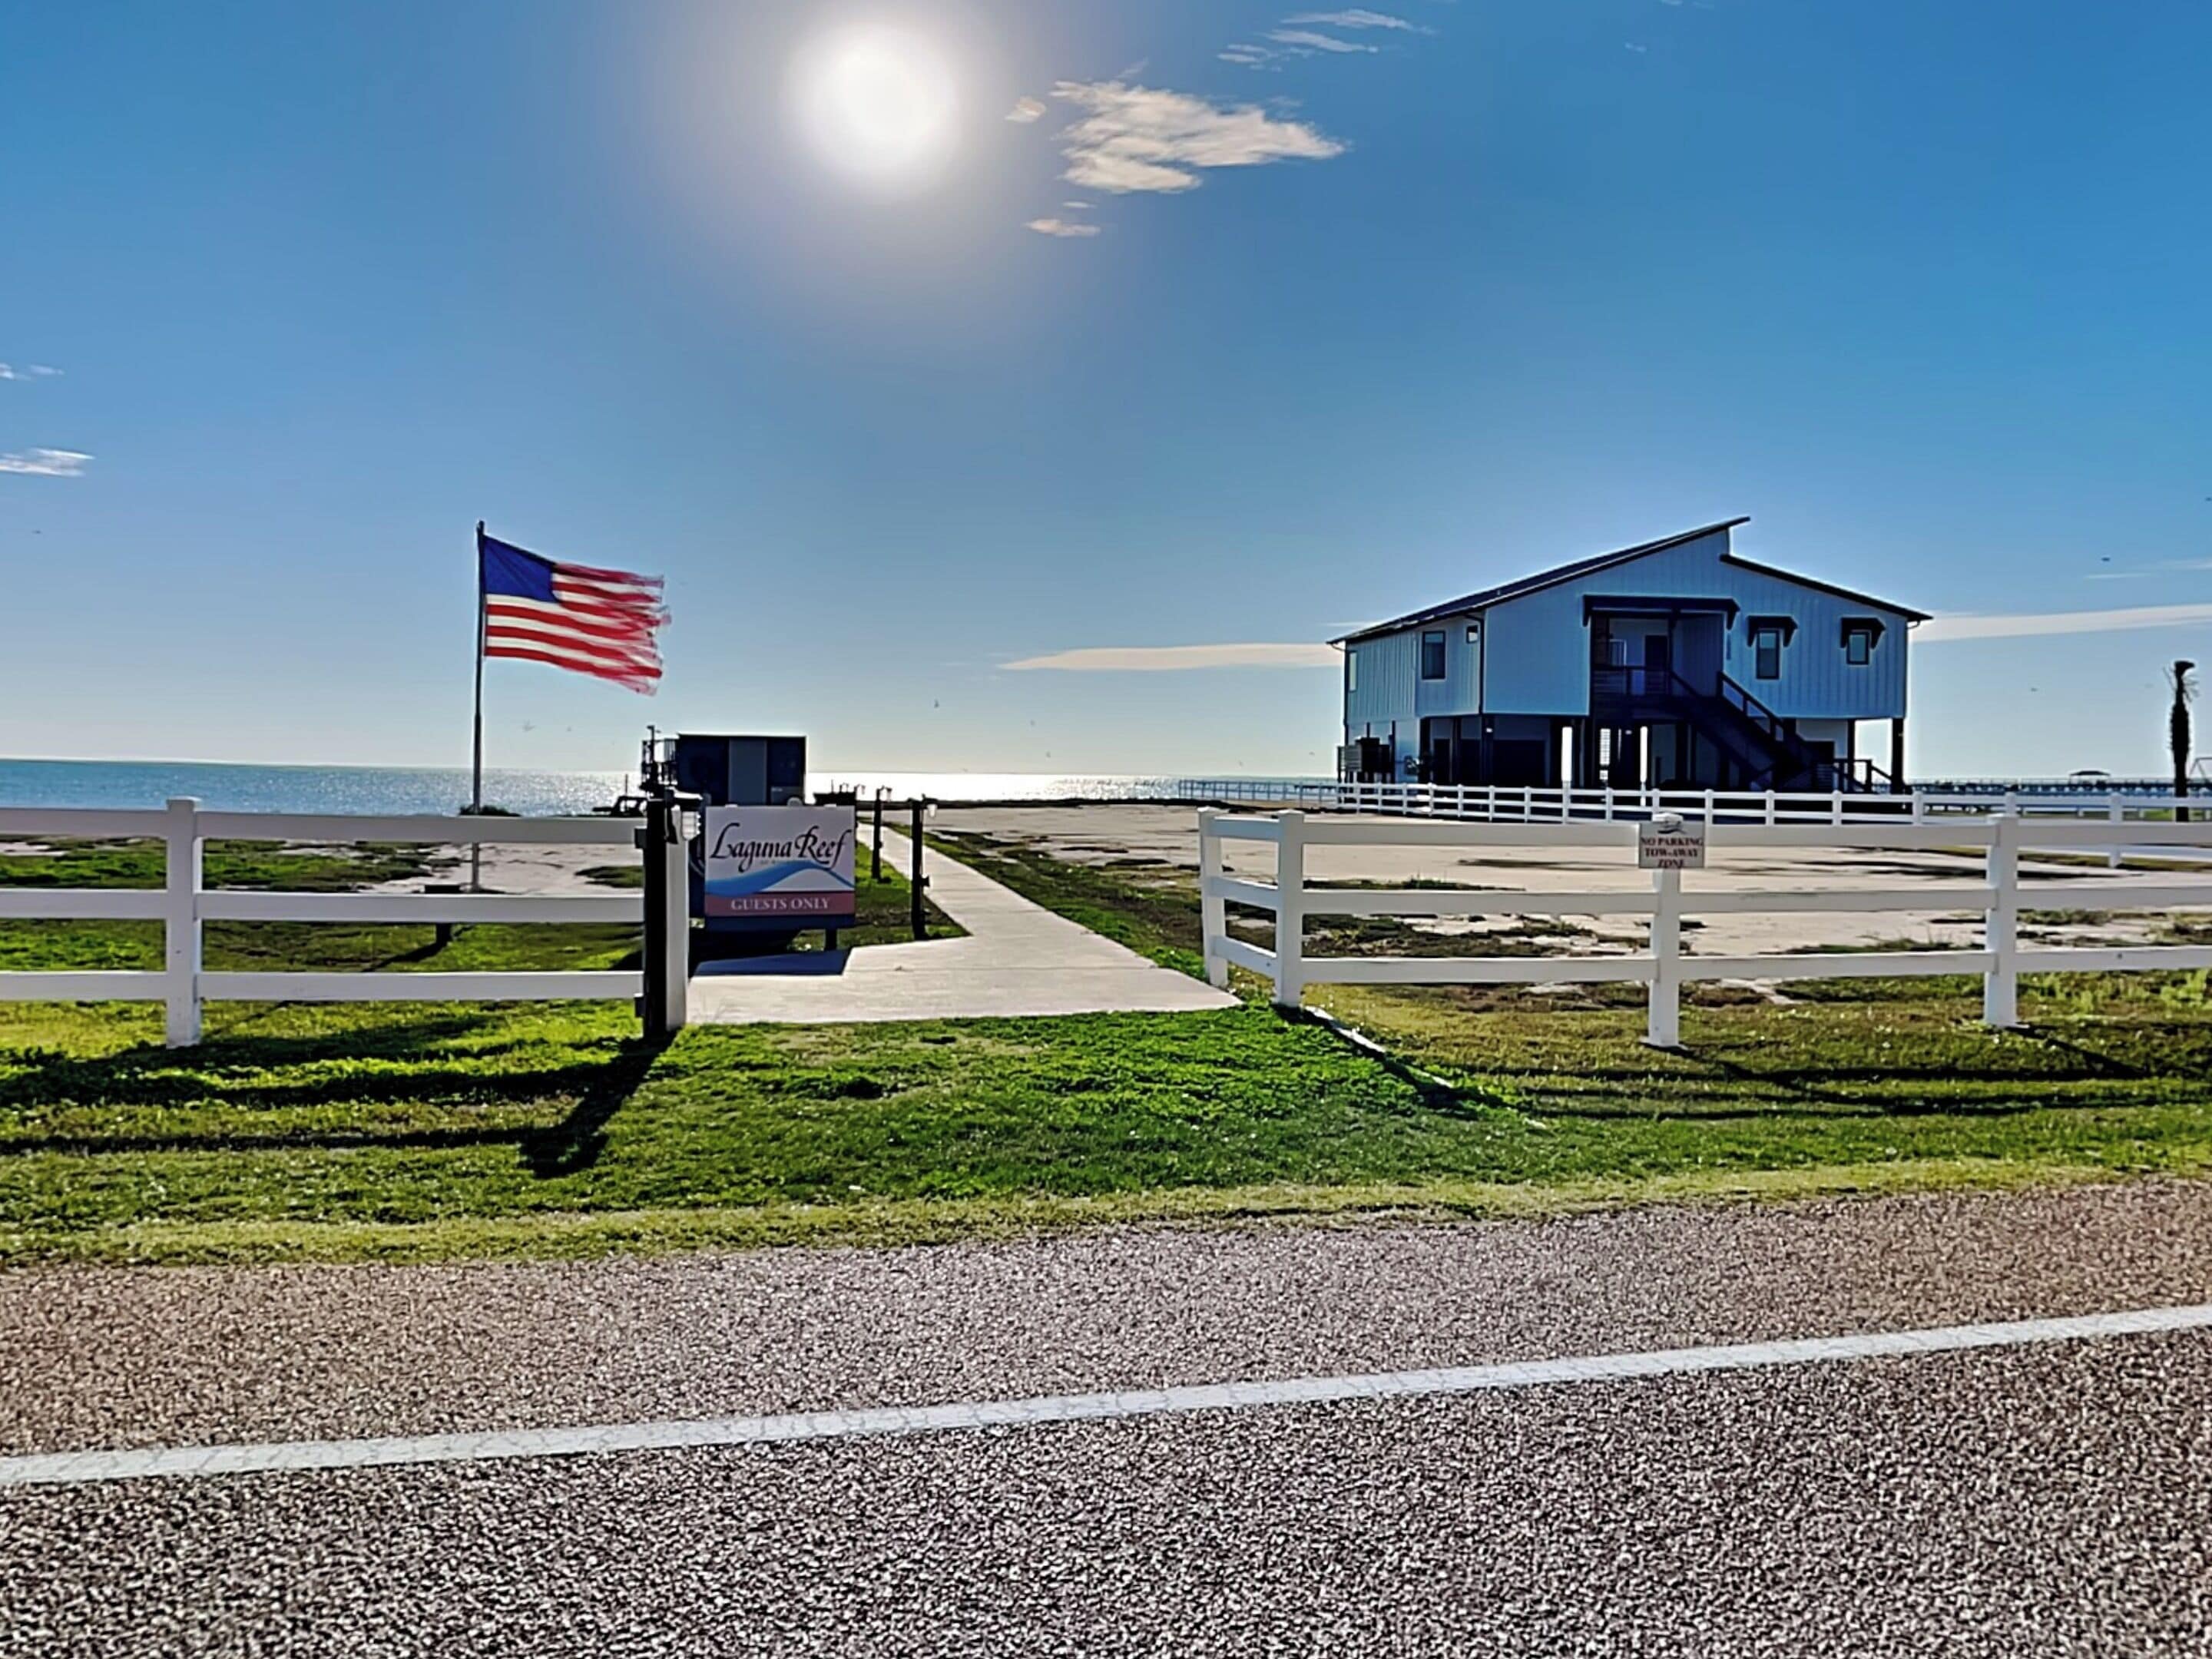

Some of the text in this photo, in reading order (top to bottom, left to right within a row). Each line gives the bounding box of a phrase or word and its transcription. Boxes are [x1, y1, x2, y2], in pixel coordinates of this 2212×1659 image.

[1640, 837, 1703, 846] NO PARKING
[710, 823, 852, 873] Laguna Reef
[1645, 848, 1698, 857] TOW-AWAY
[730, 897, 830, 910] GUESTS ONLY
